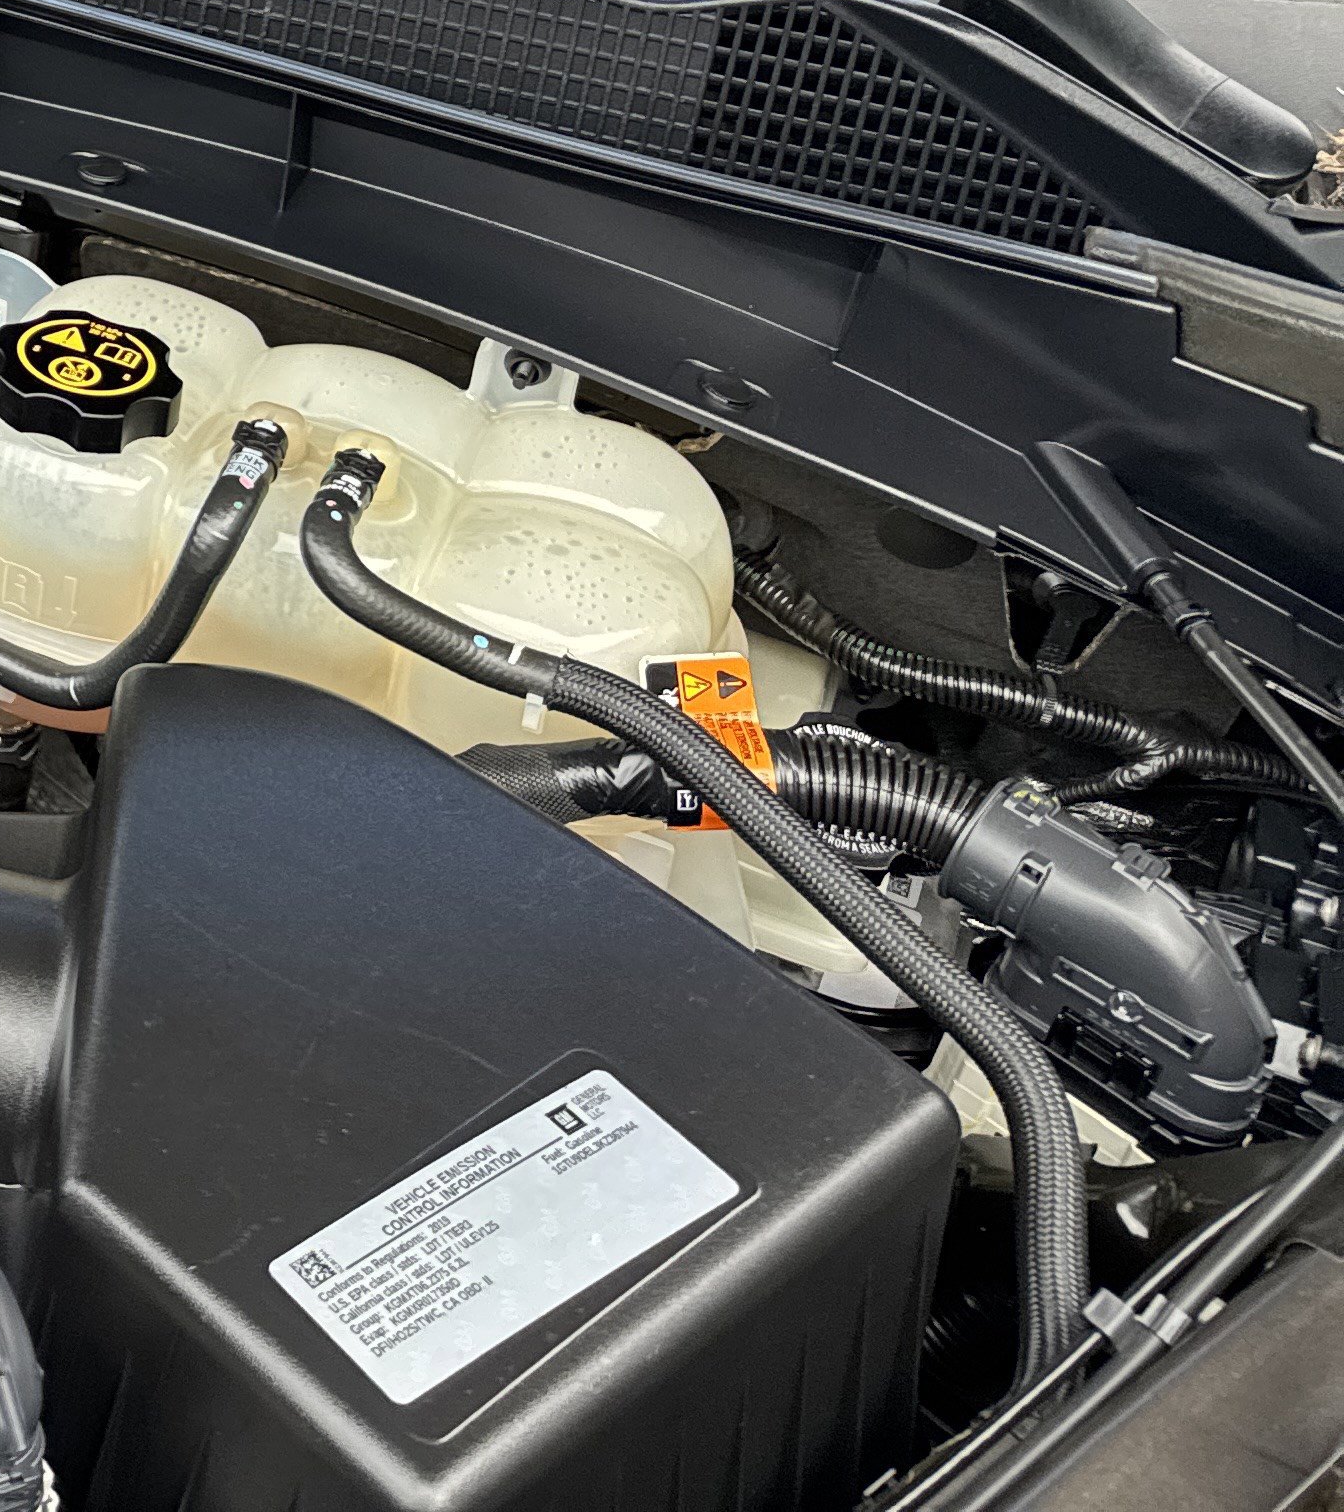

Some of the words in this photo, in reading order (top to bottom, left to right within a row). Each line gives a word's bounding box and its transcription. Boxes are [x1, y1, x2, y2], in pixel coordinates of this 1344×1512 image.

[826, 723, 872, 745] BOUCHON
[571, 1083, 605, 1105] GENERAL
[580, 1092, 610, 1112] MOTORS
[564, 1124, 602, 1149] Gasoline
[381, 1196, 442, 1236] CONTROL
[439, 1148, 521, 1200] INFORMATION
[385, 1179, 440, 1215] VEHICLE
[437, 1145, 496, 1183] EMISSION
[316, 1270, 364, 1302] Conforms
[361, 1265, 373, 1274] to
[371, 1231, 430, 1270] Regulations:
[427, 1216, 451, 1233] 2019
[328, 1296, 350, 1313] U.S.
[348, 1284, 370, 1300] EPA
[366, 1269, 393, 1288] class
[395, 1252, 421, 1270] stds:
[420, 1238, 442, 1254] LDT
[443, 1219, 472, 1240] TIER3
[338, 1292, 384, 1323] California
[381, 1277, 407, 1296] class
[409, 1260, 435, 1278] stds:
[435, 1247, 457, 1263] LDT
[458, 1220, 500, 1248] ULEV125
[349, 1310, 385, 1336] Group:
[447, 1255, 469, 1272] 6.2L
[442, 1296, 461, 1310] CA
[360, 1324, 390, 1346] Evap:
